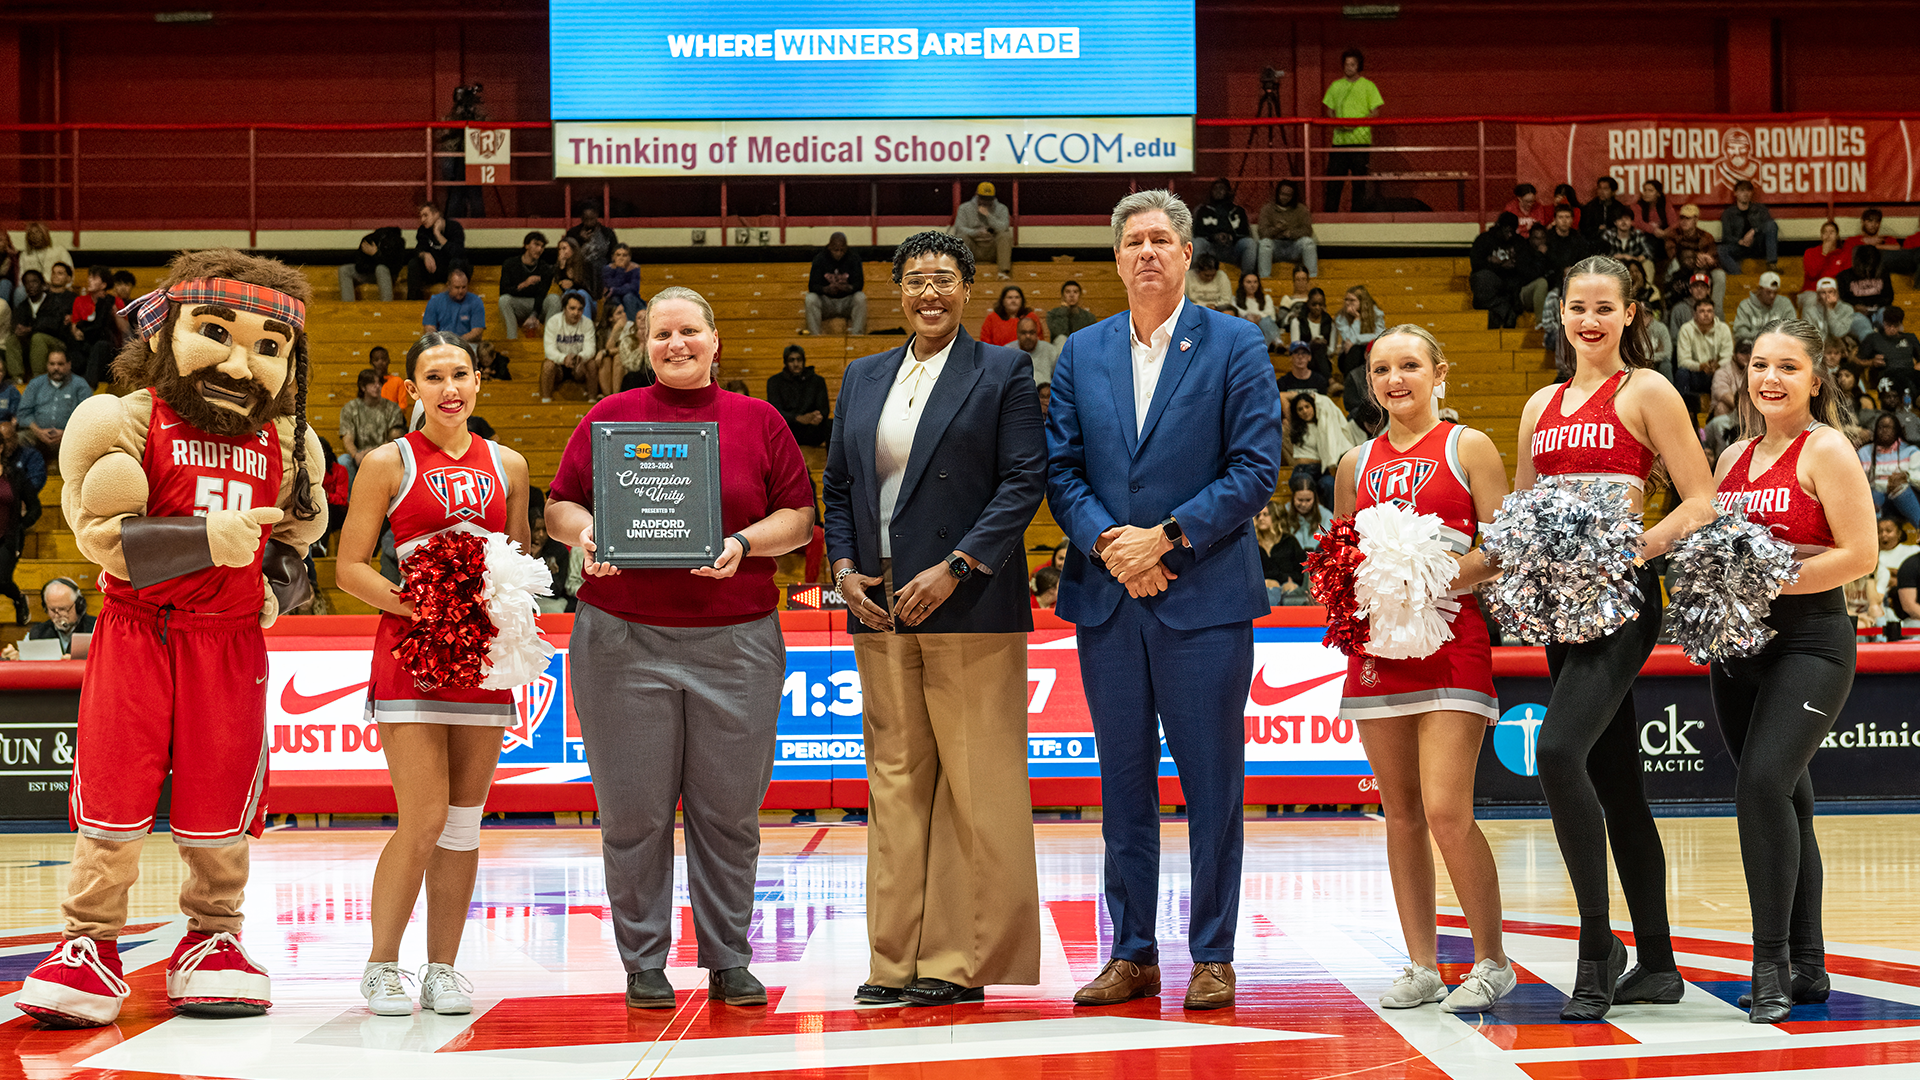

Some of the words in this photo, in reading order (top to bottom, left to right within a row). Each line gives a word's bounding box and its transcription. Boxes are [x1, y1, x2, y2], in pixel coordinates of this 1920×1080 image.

[667, 34, 773, 58] WHERE
[781, 34, 913, 55] WINNERS
[921, 32, 982, 56] ARE
[990, 33, 1073, 53] MADE
[568, 137, 697, 170] Thinking
[709, 136, 737, 163] of
[748, 135, 863, 163] Medical
[875, 134, 990, 162] School?
[1005, 132, 1176, 164] VCOM.edu
[1608, 127, 1719, 160] RADFORD
[1754, 126, 1866, 158] ROWDIES
[481, 165, 495, 183] 12
[1609, 163, 1716, 195] STUDENT
[1762, 161, 1867, 193] SECTION
[1532, 423, 1615, 457] RADFORD
[172, 439, 267, 480] RADFORD
[640, 462, 674, 470] 2023-2024
[446, 470, 478, 506] R
[616, 470, 691, 489] Champion
[1385, 460, 1414, 498] R
[193, 475, 253, 518] 50
[634, 486, 645, 496] of
[646, 486, 685, 505] Unity
[627, 529, 691, 539] UNIVERSITY
[632, 519, 685, 529] RADFORD
[270, 724, 336, 753] JUST
[342, 723, 383, 752] DO
[1244, 715, 1305, 744] JUST
[1311, 715, 1354, 744] DO
[1639, 703, 1701, 756] ck
[0, 731, 42, 765] UN
[52, 731, 74, 764] &
[782, 741, 865, 758] PERIOD:
[1029, 740, 1062, 756] TF:
[1067, 739, 1083, 757] 0
[28, 781, 48, 792] EST
[49, 781, 69, 792] 1983
